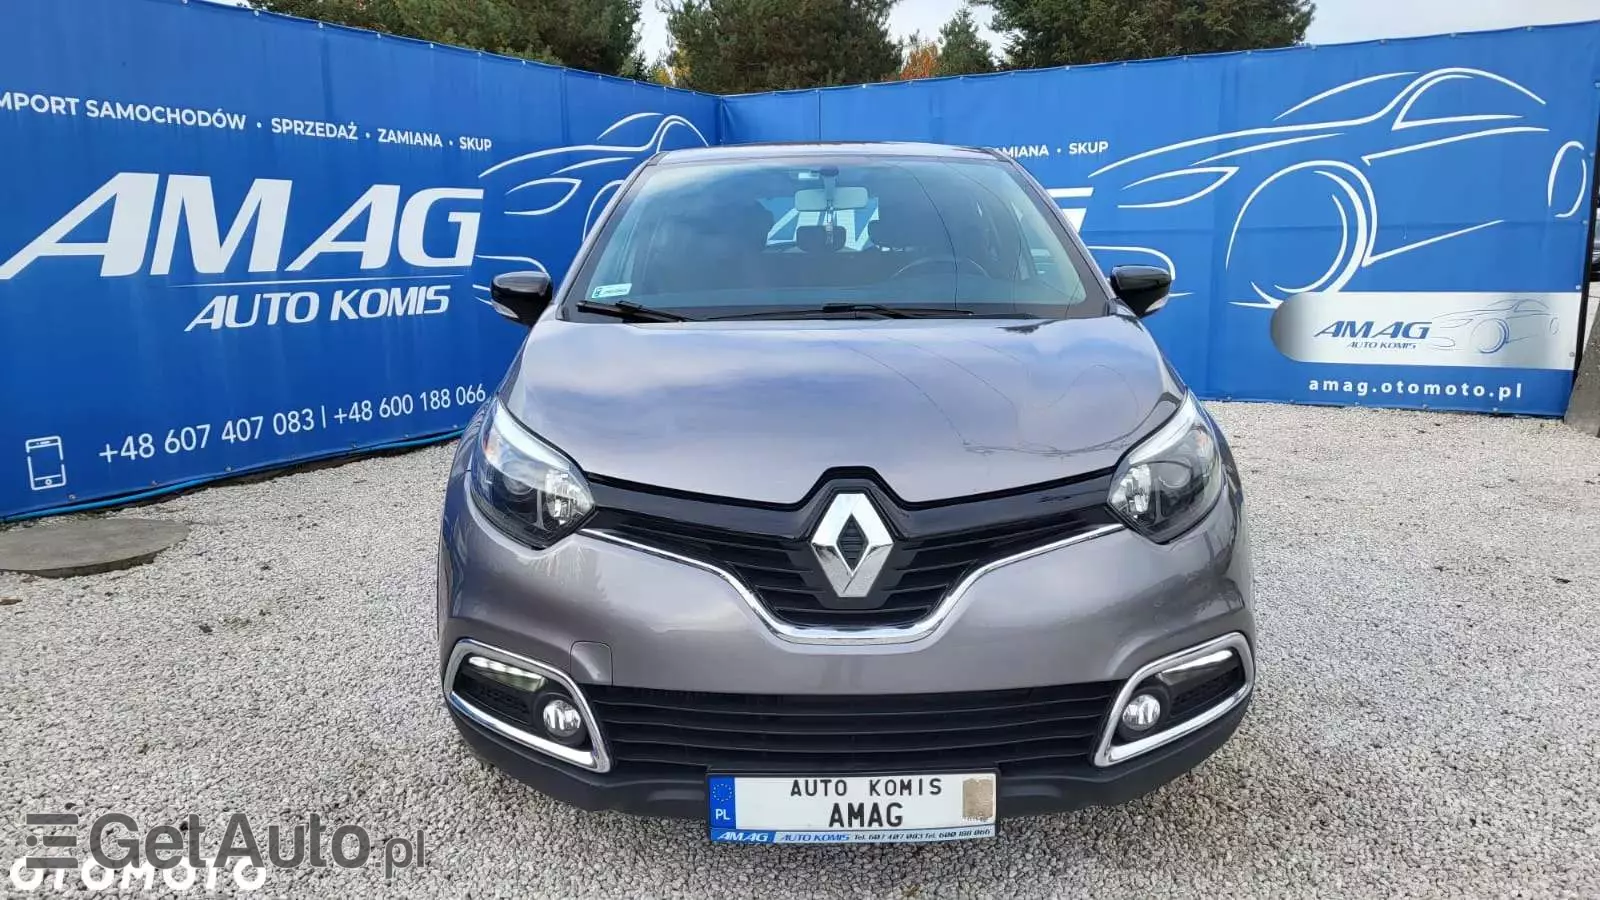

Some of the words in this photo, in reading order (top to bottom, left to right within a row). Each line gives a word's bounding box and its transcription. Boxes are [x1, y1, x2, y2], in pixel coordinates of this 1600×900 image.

[85, 99, 247, 130] SAMOCHODÓW
[271, 117, 358, 141] SPRZEDAŻ
[377, 128, 443, 148] ZAMIANA
[459, 136, 492, 151] SKUP
[1069, 141, 1109, 154] SKUP
[184, 291, 317, 332] AUTO
[330, 285, 450, 321] KOMIS
[1314, 320, 1432, 339] AMAG
[1347, 341, 1377, 349] AUTO
[1309, 379, 1522, 401] amag.otomoto.pl
[99, 433, 155, 464] +48
[164, 424, 211, 454] 607
[221, 416, 265, 444] 407
[273, 407, 315, 437] 083
[334, 400, 373, 425] +48
[380, 394, 414, 418] 600
[420, 389, 451, 412] 188
[455, 383, 487, 406] 066
[790, 779, 847, 797] AUTO
[869, 778, 942, 796] KOMIS
[715, 808, 730, 820] PL
[828, 803, 903, 828] AMAG
[718, 831, 768, 842] AMAG
